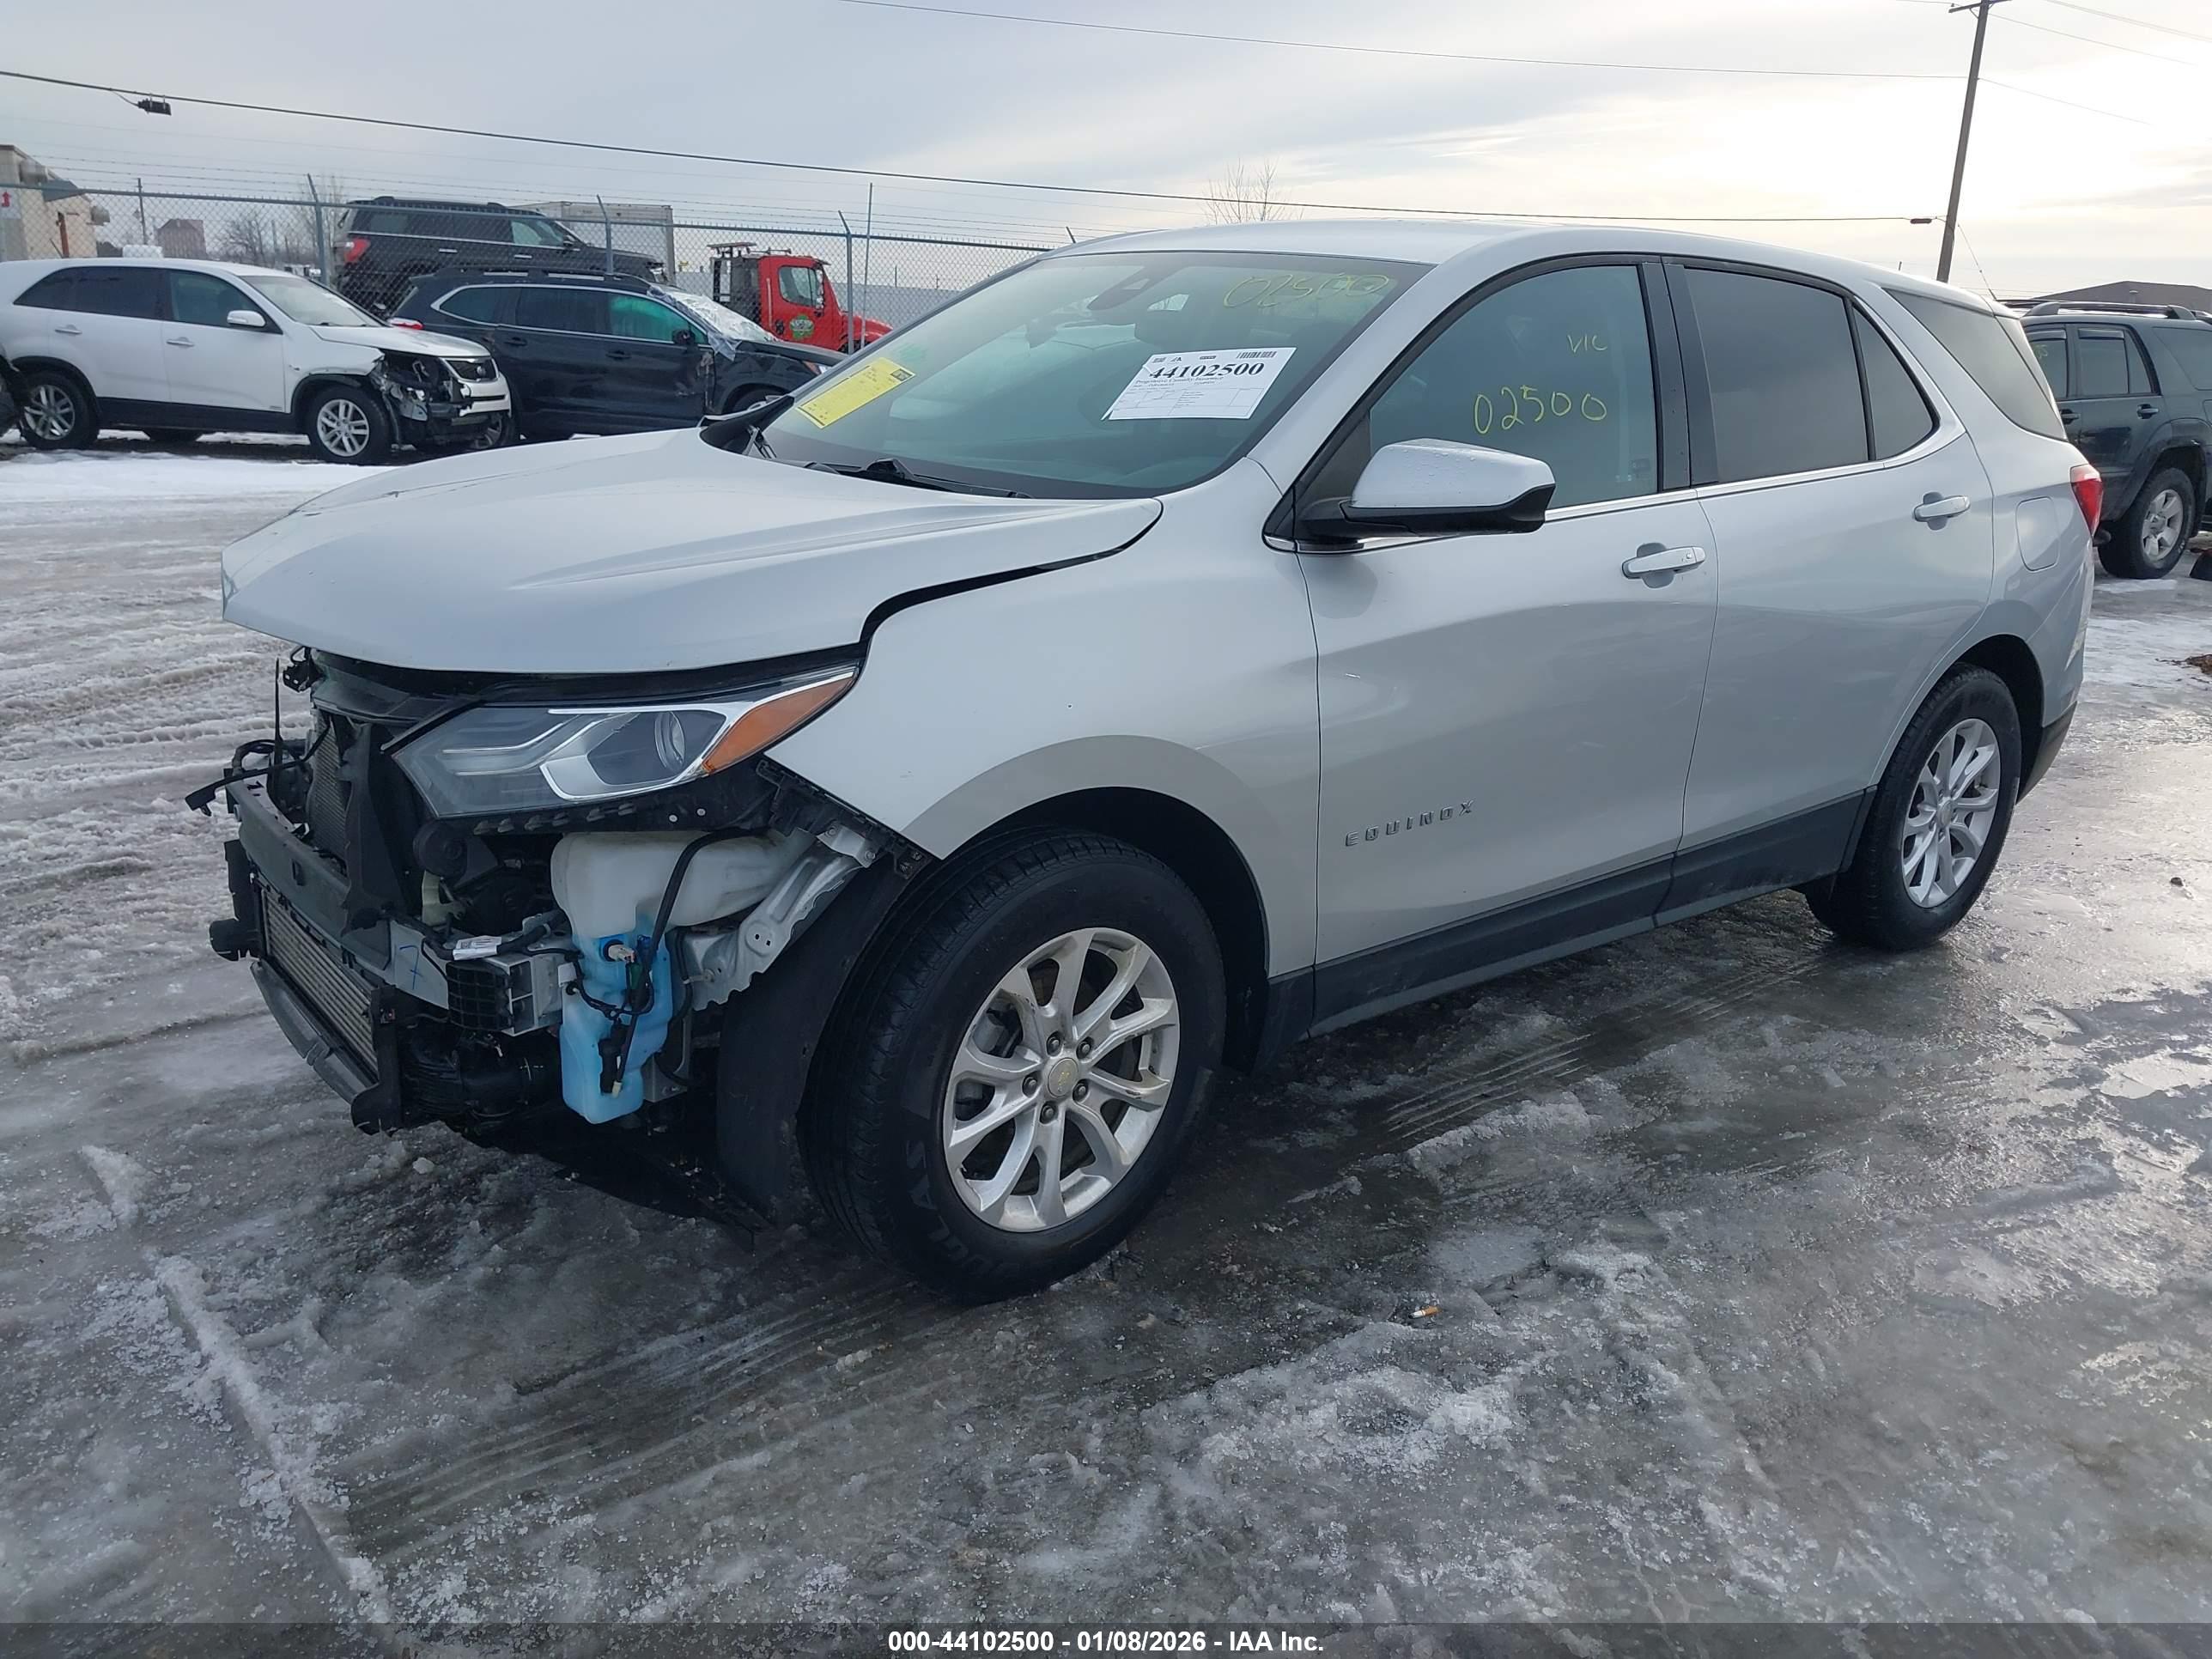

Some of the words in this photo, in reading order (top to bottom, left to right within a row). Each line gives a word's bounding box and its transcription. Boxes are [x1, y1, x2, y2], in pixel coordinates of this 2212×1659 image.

[1149, 362, 1265, 379] 44102500
[1474, 385, 1607, 434] 02500
[1345, 799, 1474, 847] EQUINOX
